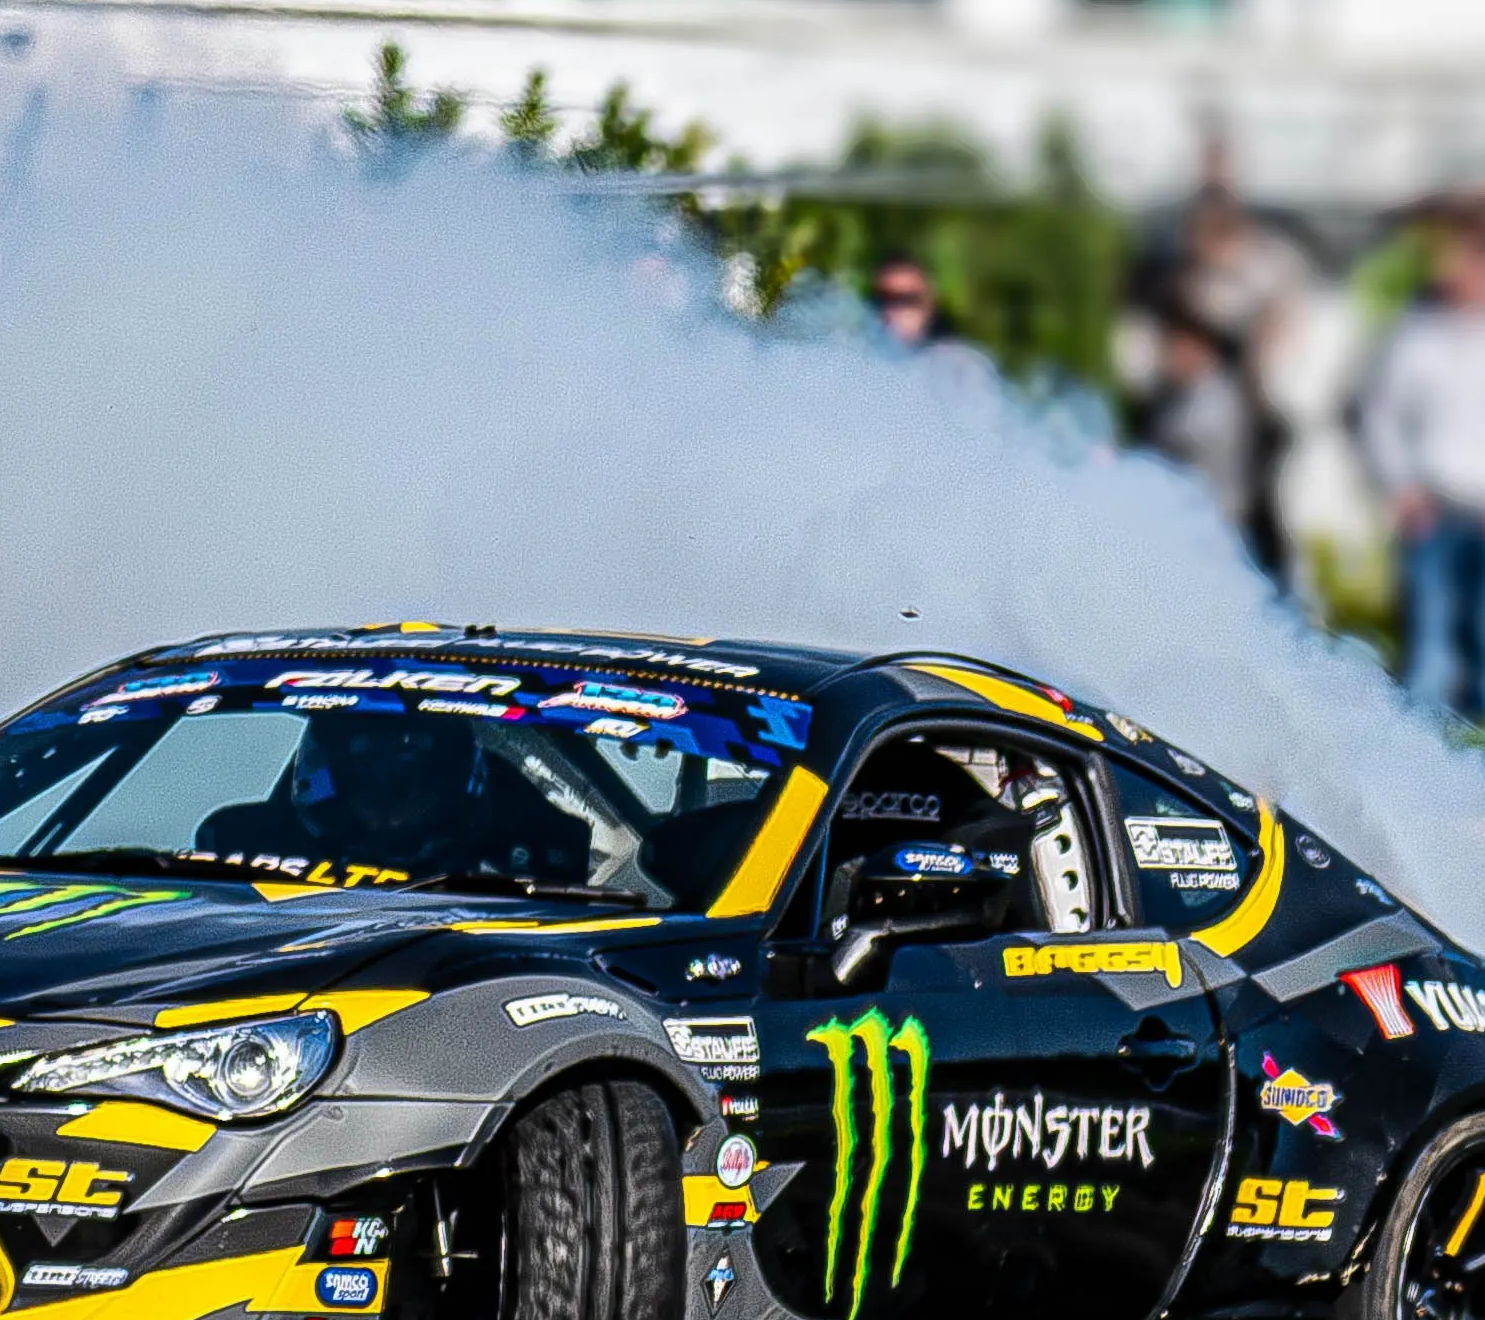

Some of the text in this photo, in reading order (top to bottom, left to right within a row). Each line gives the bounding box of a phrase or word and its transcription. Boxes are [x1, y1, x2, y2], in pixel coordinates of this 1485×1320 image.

[264, 669, 522, 700] FALKEN
[1262, 1084, 1329, 1110] SUNOCO
[941, 1090, 1156, 1172] MONSTER
[967, 1183, 1121, 1212] ENERGY
